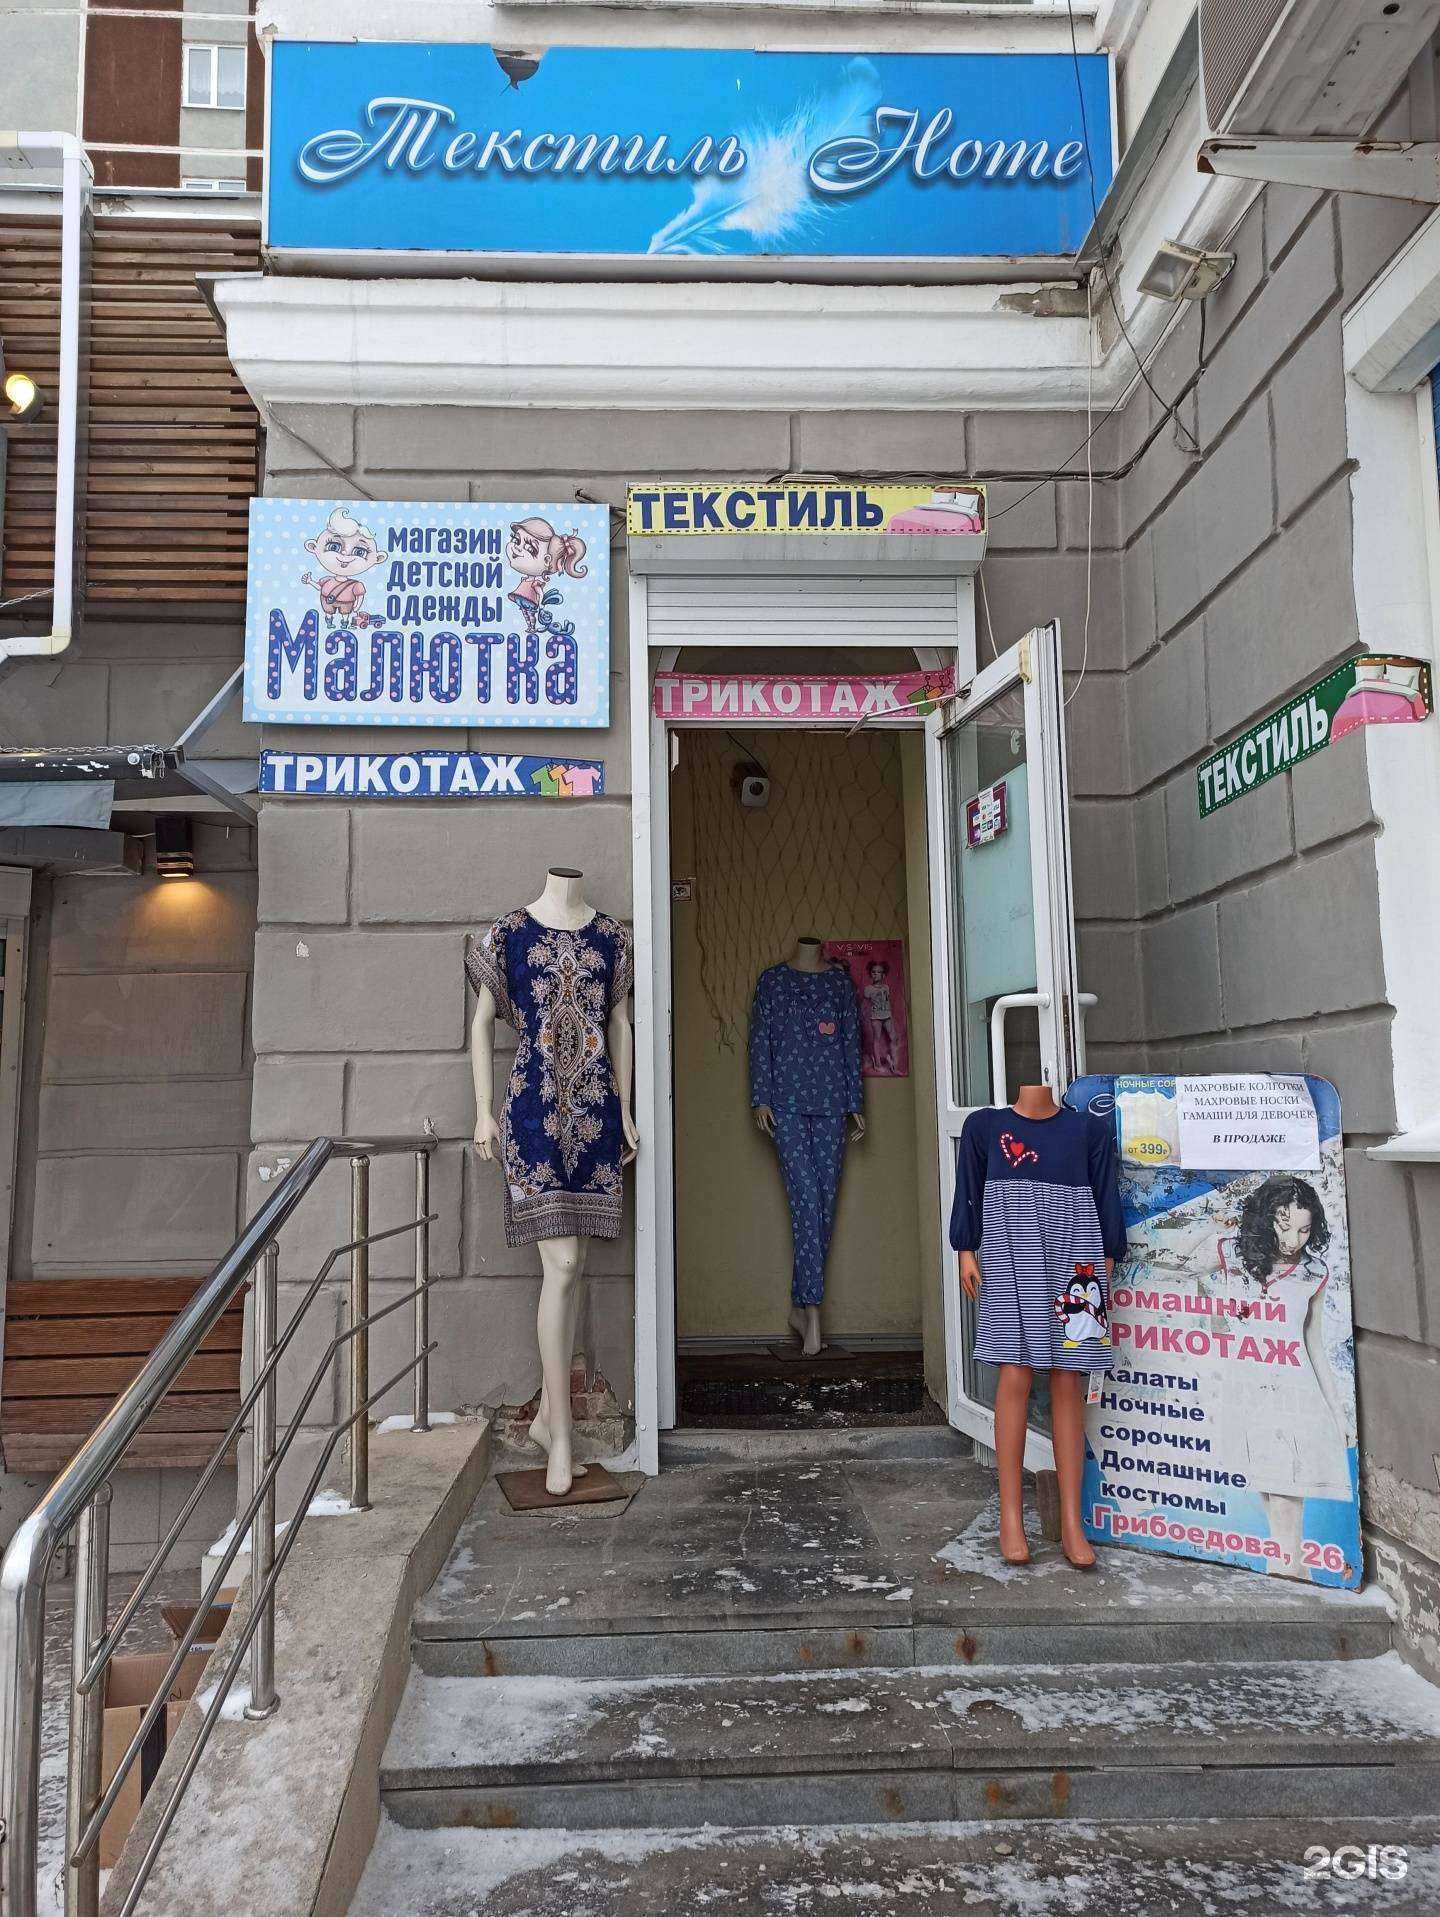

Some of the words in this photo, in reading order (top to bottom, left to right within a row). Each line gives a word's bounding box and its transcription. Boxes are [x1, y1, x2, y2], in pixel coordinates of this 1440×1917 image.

[297, 96, 748, 184] Текстиль
[809, 105, 1084, 193] Home
[631, 490, 884, 529] ТЕКСТИЛЬ
[386, 557, 503, 592] детской
[386, 594, 503, 627] одежды
[266, 607, 579, 705] Малютка
[654, 678, 900, 714] ТРИКОТАЖ
[1200, 696, 1329, 809] ТЕКСТИЛЬ
[266, 755, 526, 793] ТРИКОТАЖ
[1117, 1079, 1156, 1089] НОЧНЫЕ
[1184, 1082, 1246, 1093] МАХРОВЫЕ
[1249, 1081, 1305, 1092] КОЛГОТКИ
[1194, 1096, 1258, 1106] МАХРОВЫЕ
[1260, 1096, 1300, 1106] НОСКИ
[1183, 1111, 1233, 1121] ГАМАШИ
[1235, 1110, 1258, 1120] ДЛЯ
[1260, 1110, 1316, 1121] ДЕВОЧЕК
[1212, 1134, 1221, 1144] В
[1223, 1134, 1287, 1144] ПРОДАЖЕ
[1107, 1288, 1287, 1323] омашний
[1111, 1322, 1302, 1368] РИКОТАЖ
[1100, 1391, 1206, 1422] Ночные
[1100, 1425, 1211, 1453] сорочки
[1100, 1449, 1248, 1489] Домашние
[1101, 1482, 1227, 1516] костюмы
[1094, 1505, 1291, 1565] Грибоедова,
[1303, 1541, 1345, 1572] 26
